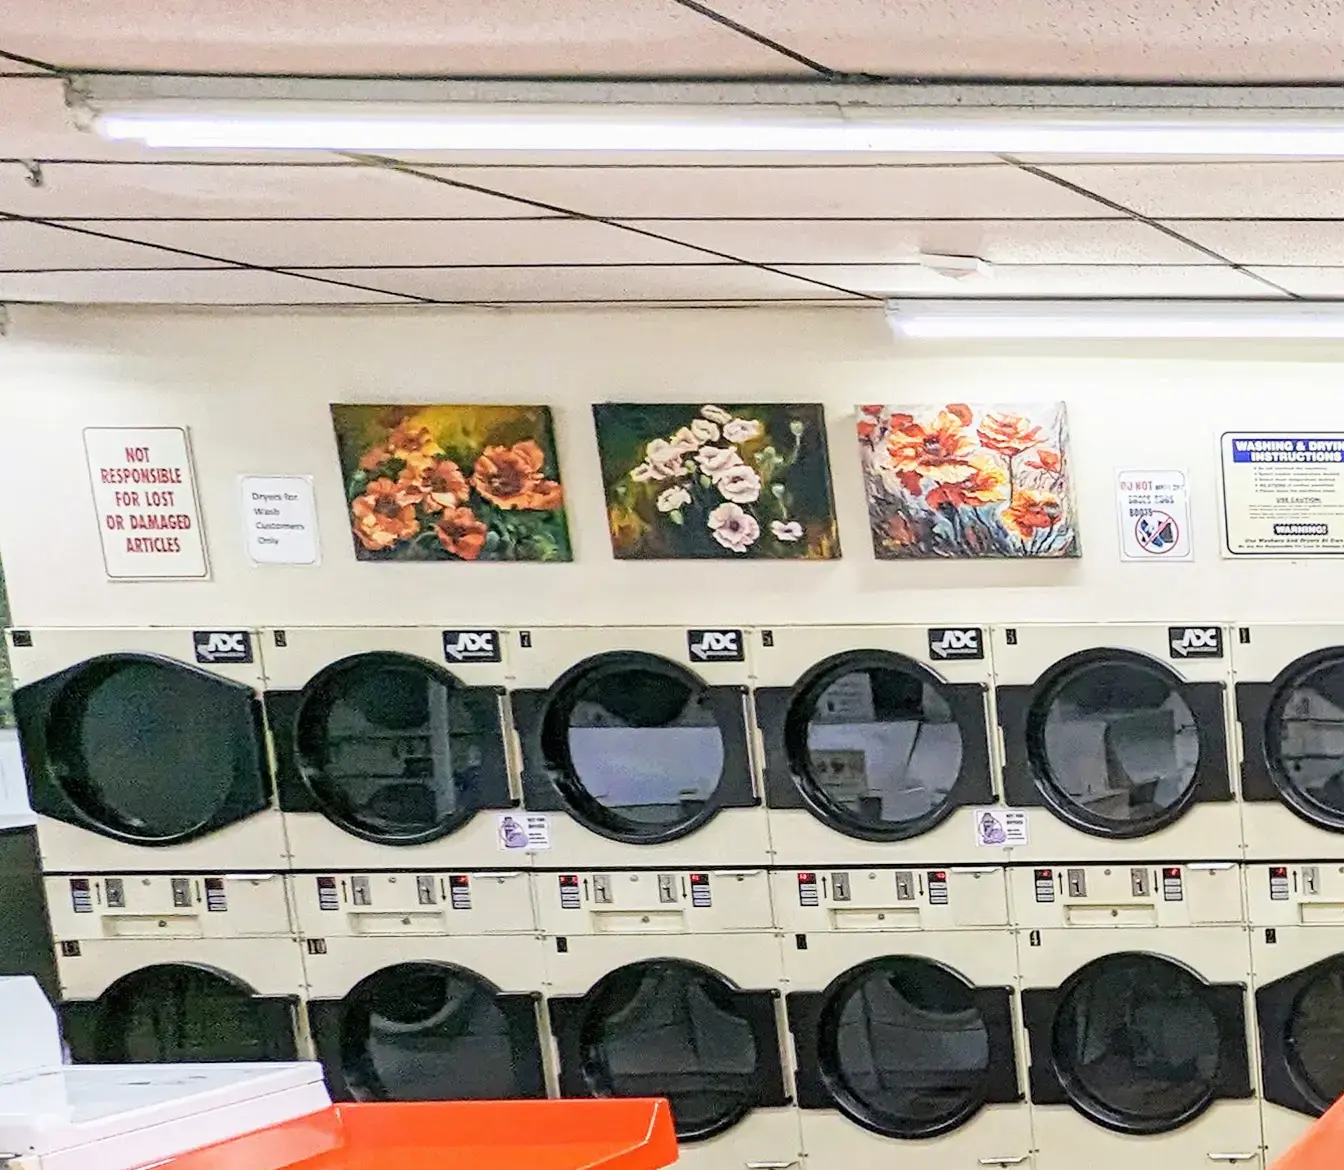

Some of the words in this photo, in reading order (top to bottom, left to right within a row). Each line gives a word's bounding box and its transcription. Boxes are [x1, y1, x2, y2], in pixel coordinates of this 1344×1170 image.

[1235, 440, 1294, 452] WASHING
[1296, 441, 1306, 451] &
[125, 447, 150, 463] NOT
[1250, 451, 1343, 462] INSTRUCTIONS
[100, 468, 182, 484] RESPONSIBLE
[1135, 480, 1153, 491] NOT
[115, 491, 139, 507] FOR
[145, 491, 175, 507] LOST
[253, 507, 280, 516] Wash
[106, 514, 125, 531] OR
[130, 514, 191, 531] DAMAGED
[255, 521, 305, 531] Customers
[1274, 524, 1328, 535] WARNING!
[126, 537, 181, 553] ARTICLES
[257, 536, 279, 546] Only
[208, 632, 245, 652] ADC
[456, 632, 493, 652] ADC
[701, 632, 738, 651] ADC
[941, 629, 978, 649] ADC
[1182, 628, 1218, 648] ADC
